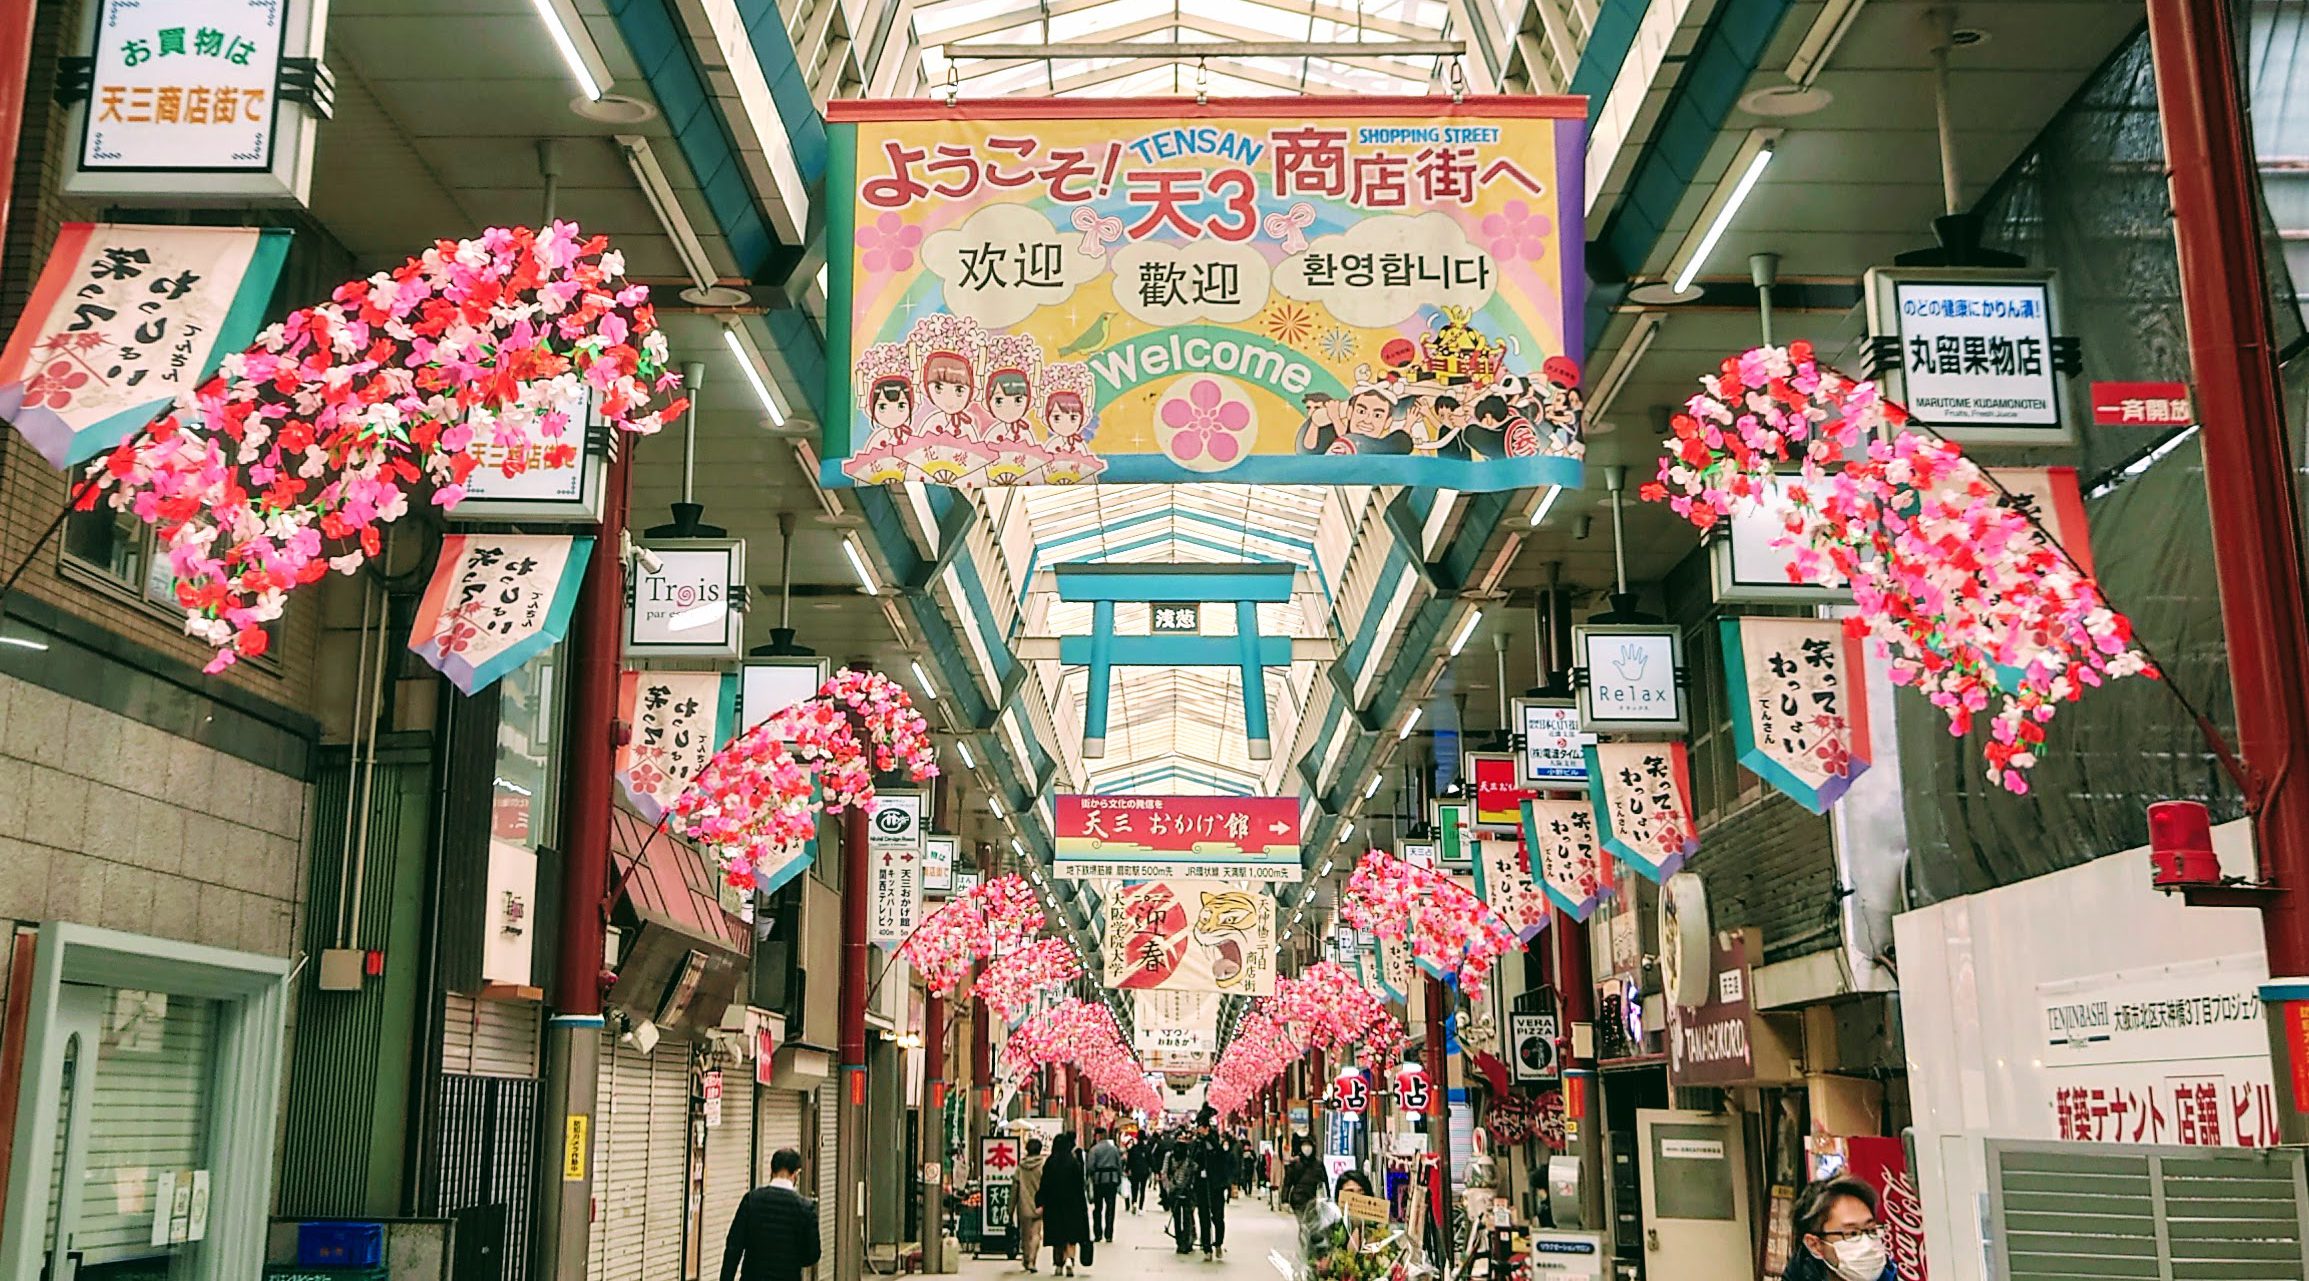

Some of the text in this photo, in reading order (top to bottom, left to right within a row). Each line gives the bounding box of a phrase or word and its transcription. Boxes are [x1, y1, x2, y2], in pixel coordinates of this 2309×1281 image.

[120, 26, 257, 68] お買物は
[100, 84, 267, 125] 天三商店街で
[1129, 128, 1264, 166] TENSAN
[1359, 127, 1499, 144] SHOPPING STREET
[956, 240, 1066, 292] 欢迎
[1138, 261, 1241, 308] 歡迎
[1302, 251, 1490, 292] 환영합니다
[1090, 333, 1313, 394] Welcome
[1908, 334, 2042, 377] 丸留果物店
[1916, 398, 2047, 410] MARUTOME KUDAMONOTEN
[2096, 398, 2190, 422] 一斉開放
[645, 577, 719, 607] Trois
[1599, 685, 1666, 702] Relax
[1801, 638, 1838, 715] 笑って
[1759, 698, 1776, 745] てんさん
[1768, 651, 1807, 754] わっしょい
[1620, 767, 1650, 841] わっしょい
[1643, 755, 1672, 810] 笑って
[1082, 809, 1250, 840] 天三 おかげ館
[1571, 811, 1593, 859] 笑って
[1615, 801, 1628, 835] てんさん
[1550, 820, 1574, 883] わっしょい
[900, 869, 912, 927] 天三おかげ館
[1496, 859, 1514, 914] わっしょい
[1109, 893, 1125, 977] 大阪学院大学
[1133, 906, 1168, 972] 迎春
[1244, 951, 1257, 992] 商店街
[1517, 1019, 1552, 1027] VERA
[1685, 1018, 1745, 1063] TANAGOKORO
[1346, 1079, 1366, 1108] 占
[1405, 1075, 1427, 1107] 占
[2057, 1080, 2281, 1149] 新築テナント 店舗 ビル
[985, 1142, 1016, 1171] 本
